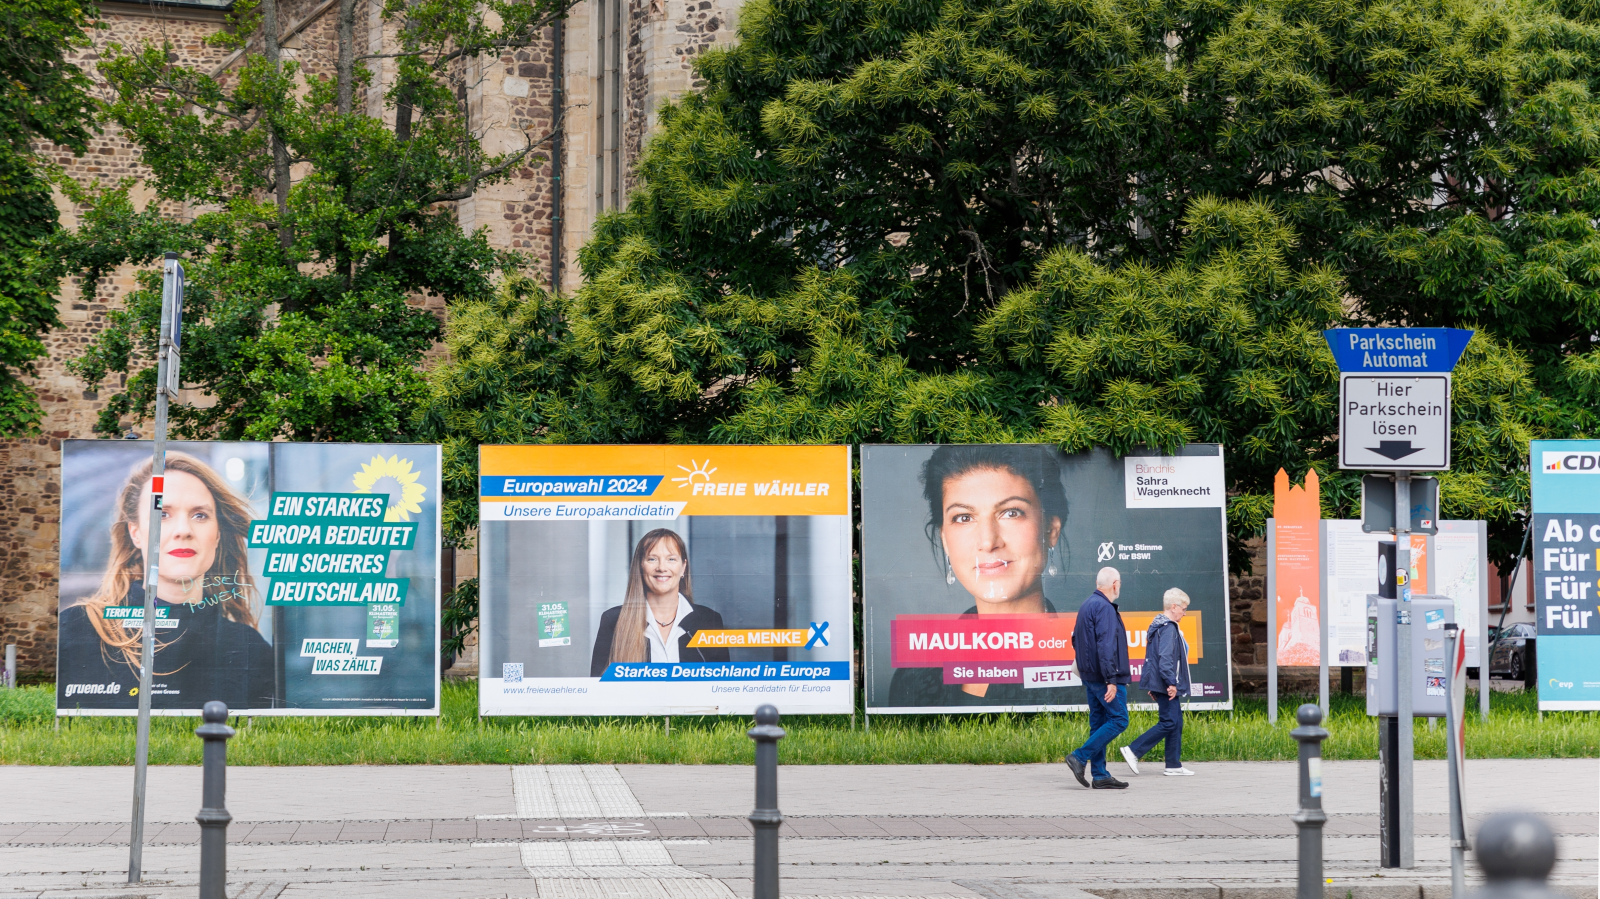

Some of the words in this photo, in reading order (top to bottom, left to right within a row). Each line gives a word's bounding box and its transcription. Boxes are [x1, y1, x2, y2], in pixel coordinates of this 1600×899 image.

[1349, 333, 1436, 350] Parkschein
[1363, 351, 1428, 368] Automat
[1377, 382, 1412, 396] Hier
[1348, 402, 1442, 416] Parkschein
[1373, 420, 1416, 435] lösen
[1135, 464, 1175, 473] Bündnis
[1563, 455, 1600, 470] CD
[503, 478, 604, 496] Europawahl
[607, 478, 648, 493] 2024
[692, 483, 747, 496] FREIE
[754, 480, 830, 496] WÄHLER
[1136, 476, 1168, 485] Sahra
[1137, 487, 1211, 497] Wagenknecht
[273, 496, 304, 516] EIN
[305, 497, 383, 517] STARKES
[503, 505, 551, 517] Unsere
[556, 505, 674, 518] Europakandidatin
[251, 525, 321, 544] EUROPA
[325, 526, 413, 546] BEDEUTET
[1543, 519, 1583, 542] Ab
[268, 553, 299, 573] EIN
[300, 554, 384, 574] SICHERES
[1544, 547, 1590, 571] Für
[271, 582, 401, 603] DEUTSCHLAND.
[1545, 575, 1591, 600] Für
[105, 608, 132, 618] TERRY
[1546, 604, 1592, 628] Für
[697, 632, 745, 644] Andrea
[748, 631, 801, 644] MENKE
[909, 632, 1034, 650] MAULKORB
[1038, 637, 1067, 649] oder
[304, 642, 354, 656] MACHEN,
[316, 659, 340, 672] WAS
[342, 657, 377, 672] ZÄHLT.
[614, 666, 668, 678] Starkes
[671, 665, 761, 678] Deutschland
[764, 665, 777, 677] in
[780, 665, 831, 679] Europa
[953, 667, 974, 678] Sie
[977, 667, 1018, 678] haben
[1032, 671, 1072, 683] JETZT
[65, 681, 121, 697] gruene.de
[503, 686, 588, 694] www.freiewaehler.eu
[711, 685, 740, 693] Unsere
[742, 685, 786, 693] Kandidatin
[802, 685, 831, 693] Europa
